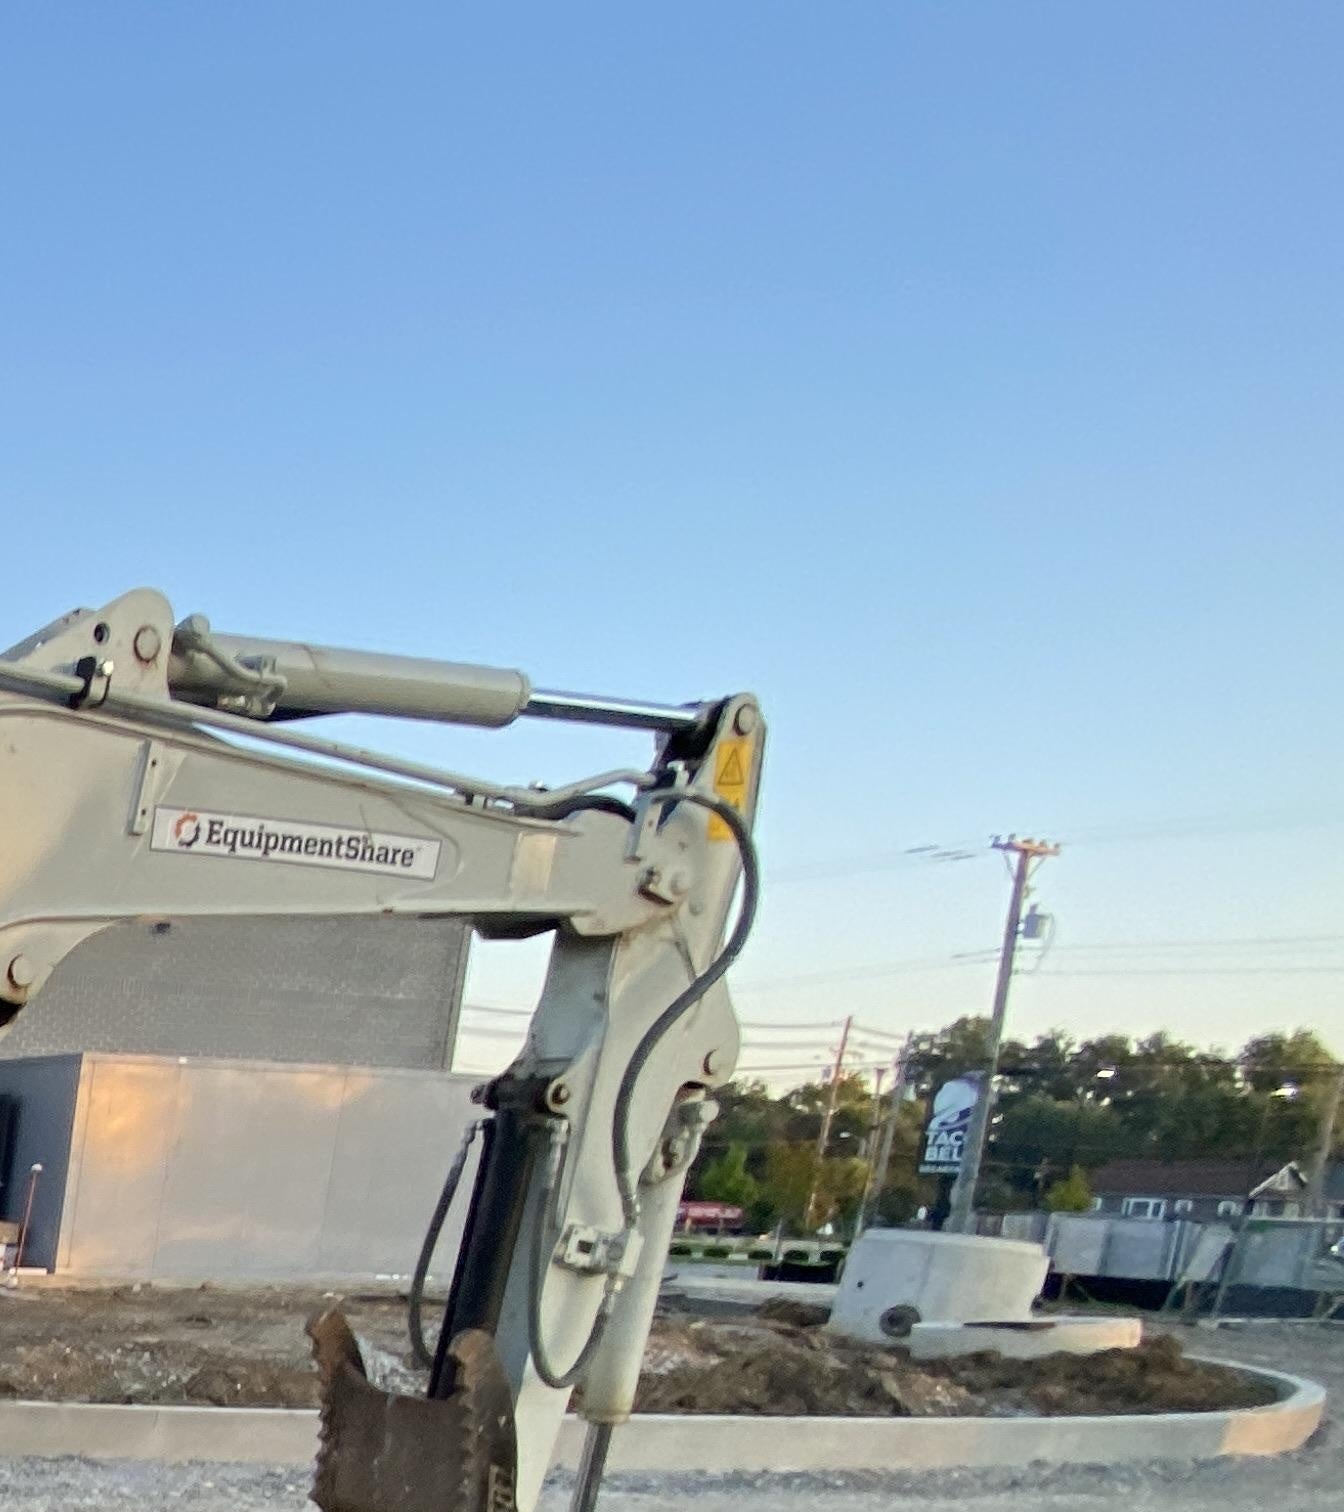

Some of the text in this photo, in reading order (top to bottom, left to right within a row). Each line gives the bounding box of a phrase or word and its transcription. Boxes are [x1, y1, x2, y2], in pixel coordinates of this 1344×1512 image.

[205, 819, 415, 868] EquipmentShare
[924, 1130, 965, 1146] TAC
[924, 1145, 963, 1161] BEL
